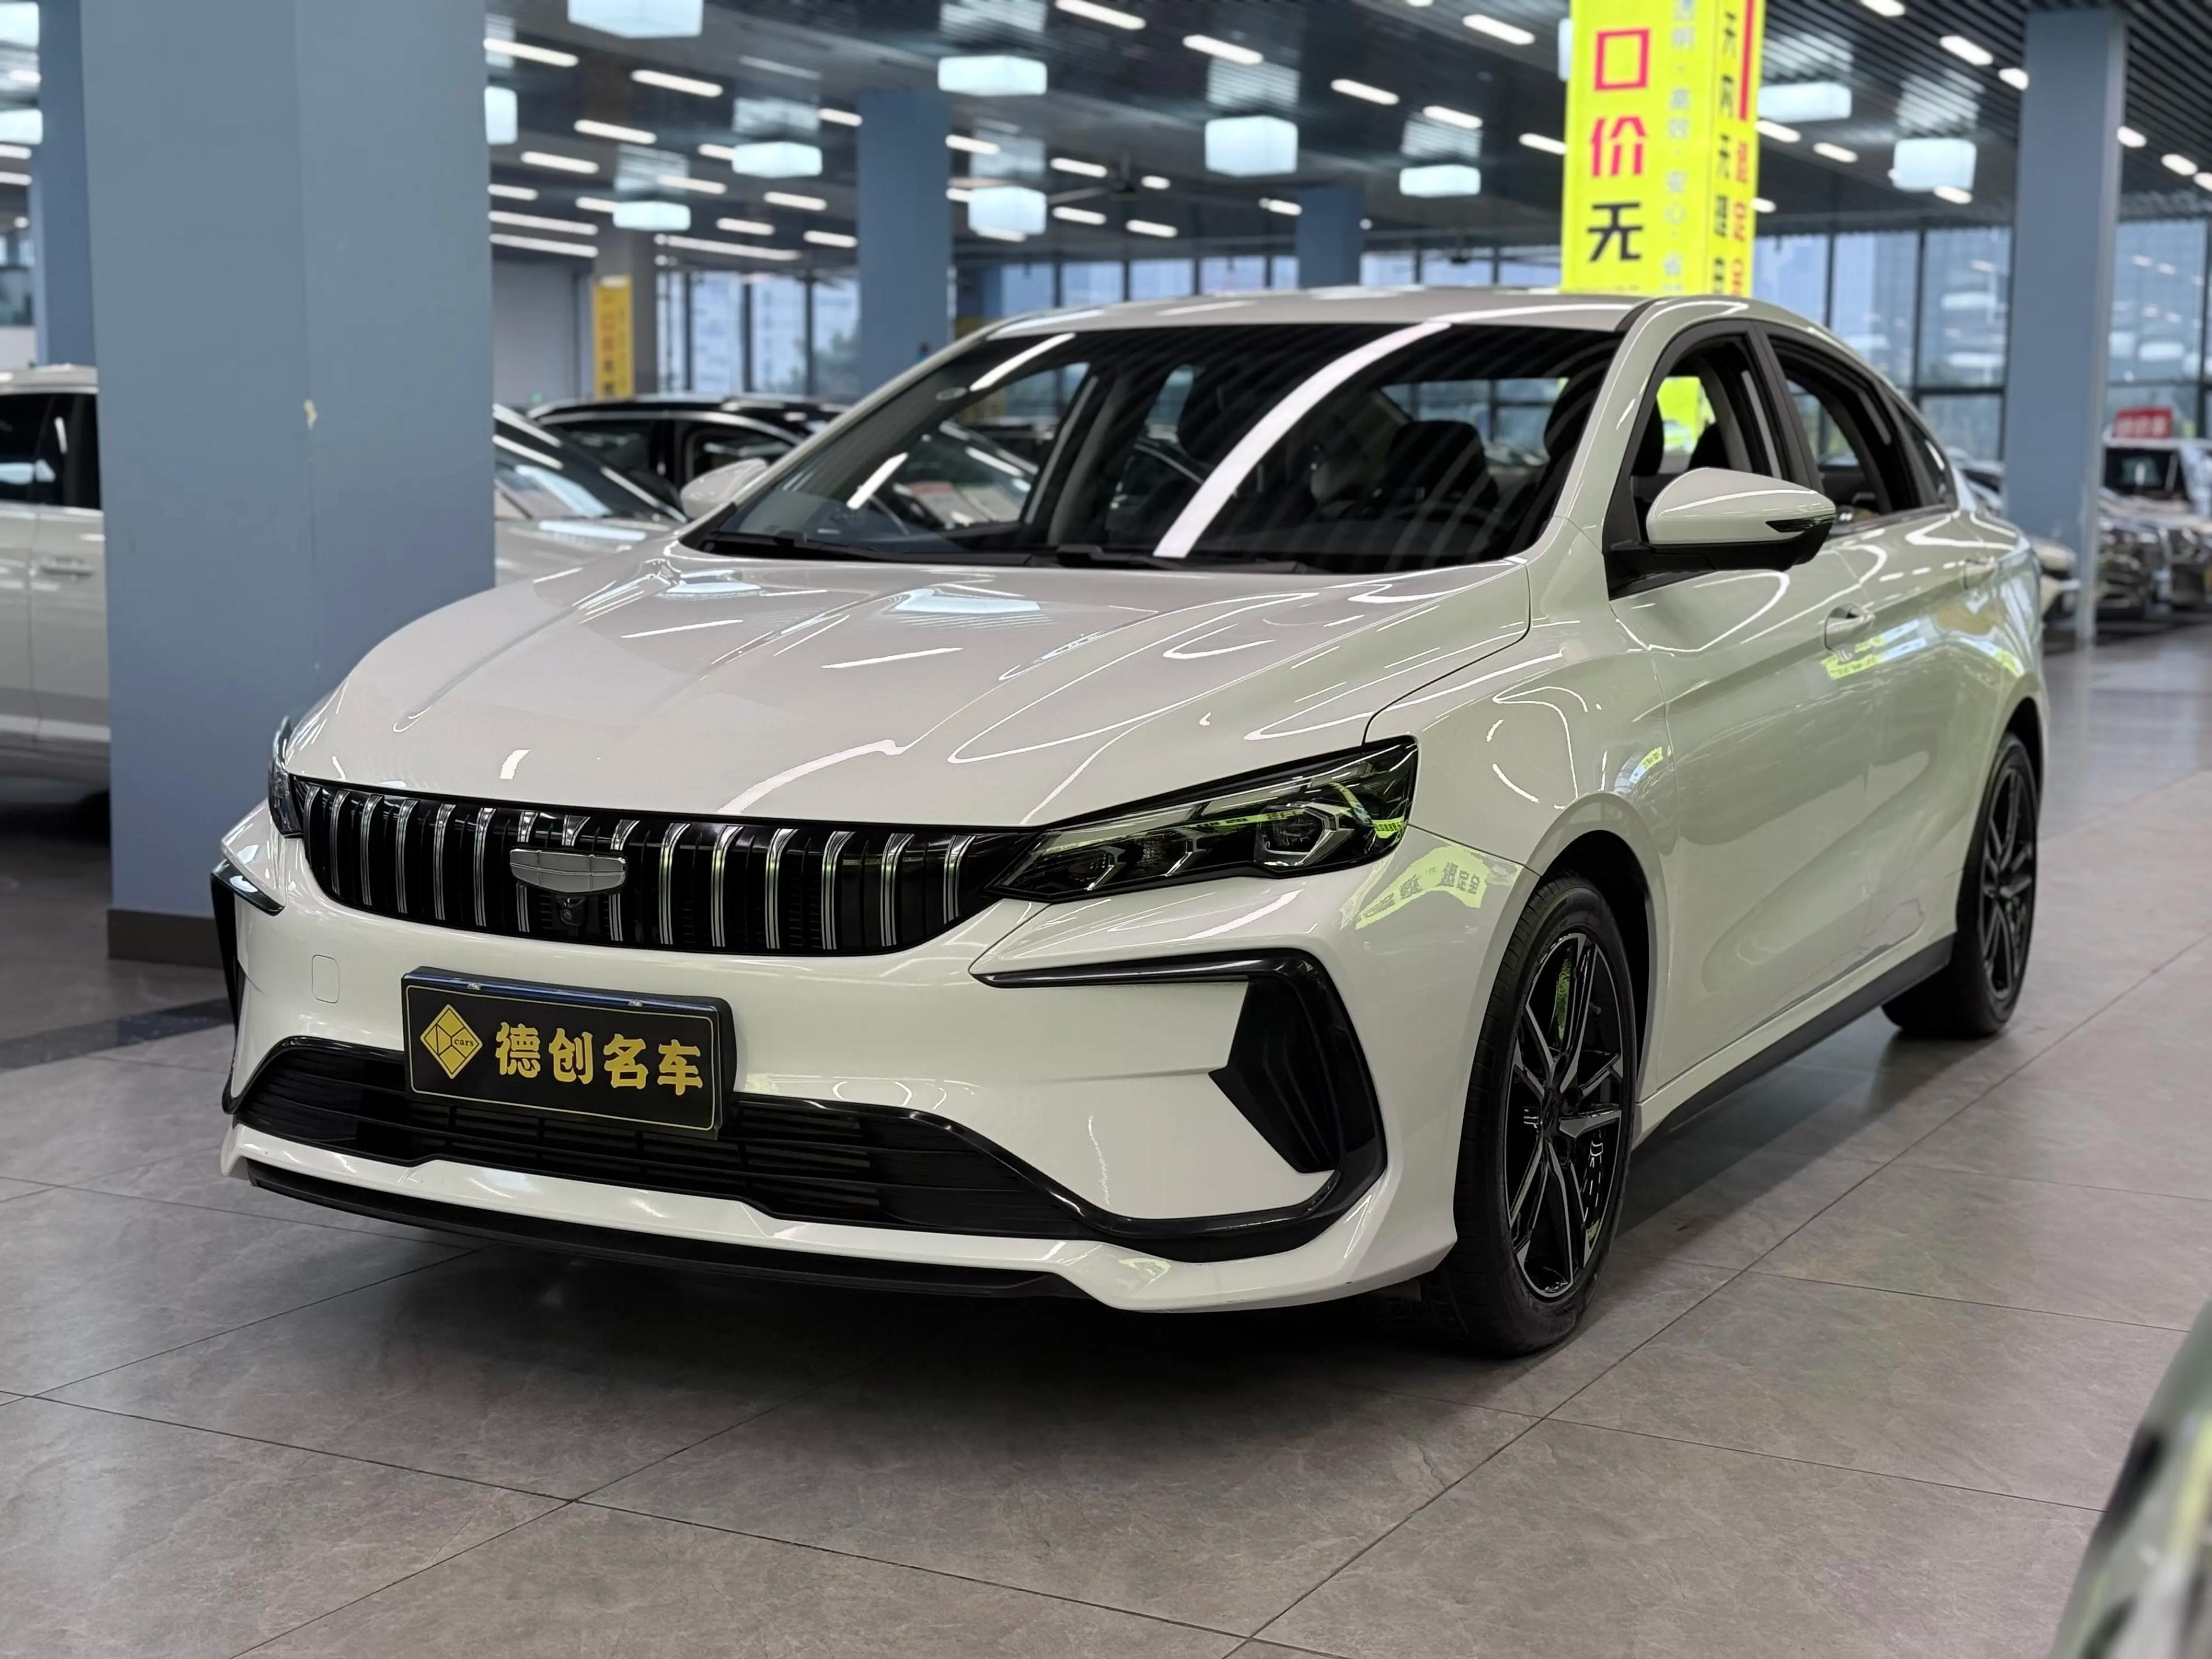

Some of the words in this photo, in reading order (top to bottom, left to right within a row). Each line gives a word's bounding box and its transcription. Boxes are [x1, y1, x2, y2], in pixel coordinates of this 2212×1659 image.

[1586, 28, 1652, 293] 口价无
[454, 1039, 474, 1047] cars
[495, 1022, 703, 1095] 德创名车
